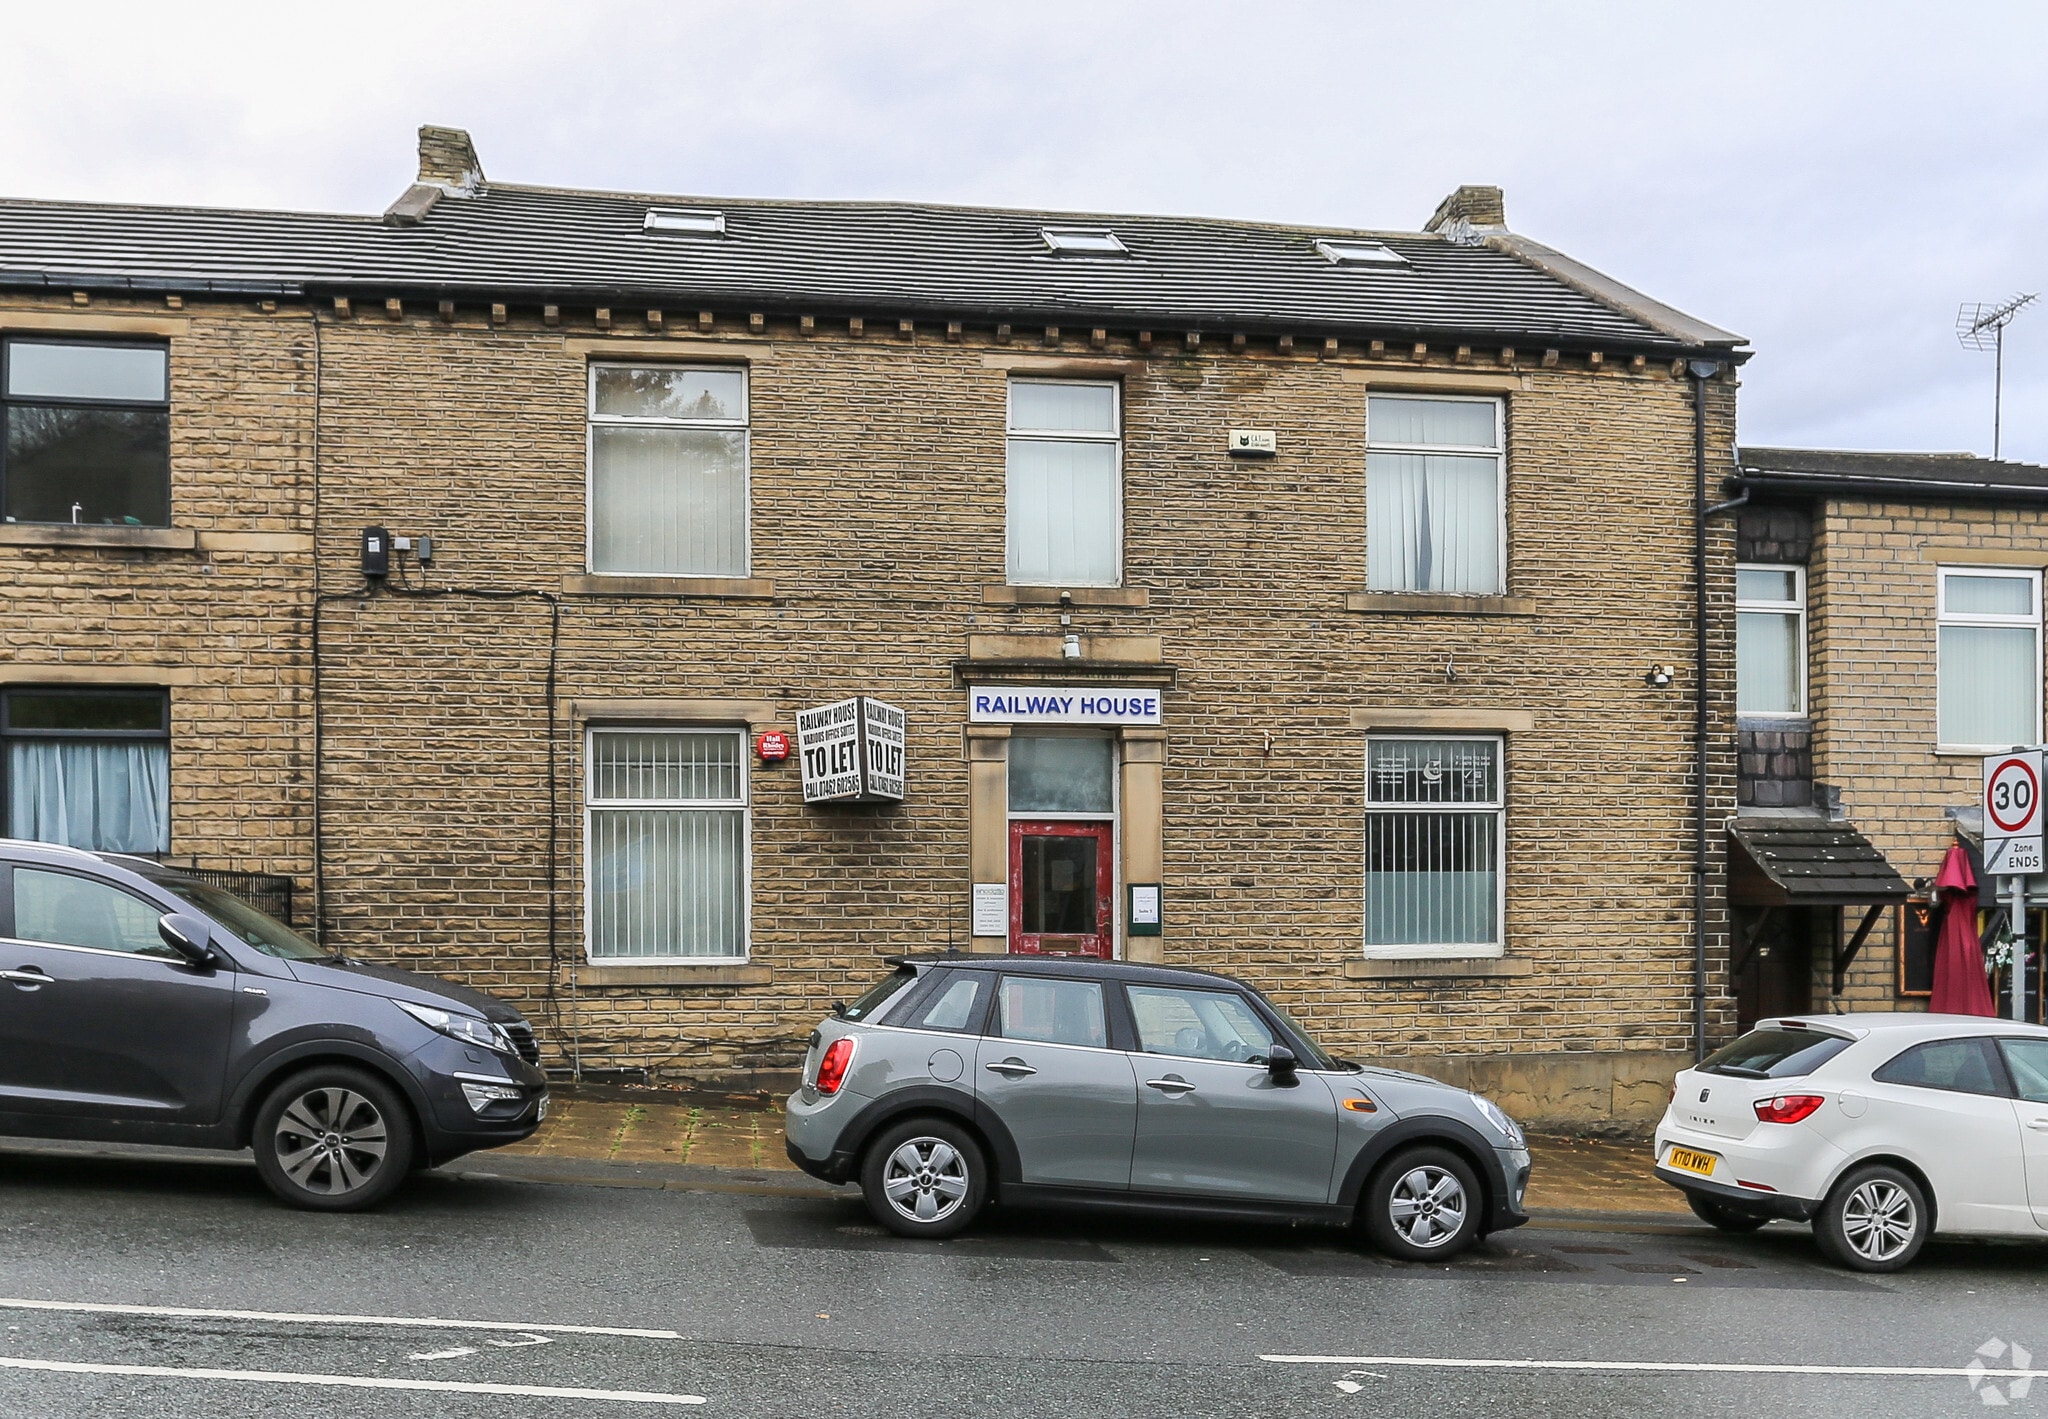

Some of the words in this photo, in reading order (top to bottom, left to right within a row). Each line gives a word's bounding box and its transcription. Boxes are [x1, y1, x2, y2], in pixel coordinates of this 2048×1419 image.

[976, 696, 1073, 714] RAILWAY
[1081, 697, 1156, 715] HOUSE
[800, 709, 832, 731] RAILWAY
[833, 702, 855, 724] HOUSE
[803, 731, 825, 745] VARIOUS
[825, 727, 840, 741] OFFICE
[840, 723, 855, 737] SUITES
[804, 746, 827, 779] TO
[831, 739, 856, 774] LET
[868, 738, 883, 772] TO
[886, 743, 902, 777] LET
[806, 782, 818, 799] CALL
[1995, 780, 2030, 810] 30
[2014, 843, 2033, 852] Zone
[2009, 856, 2039, 868] ENDS
[1689, 1115, 1715, 1125] IBIZA
[1672, 1150, 1692, 1167] KT10
